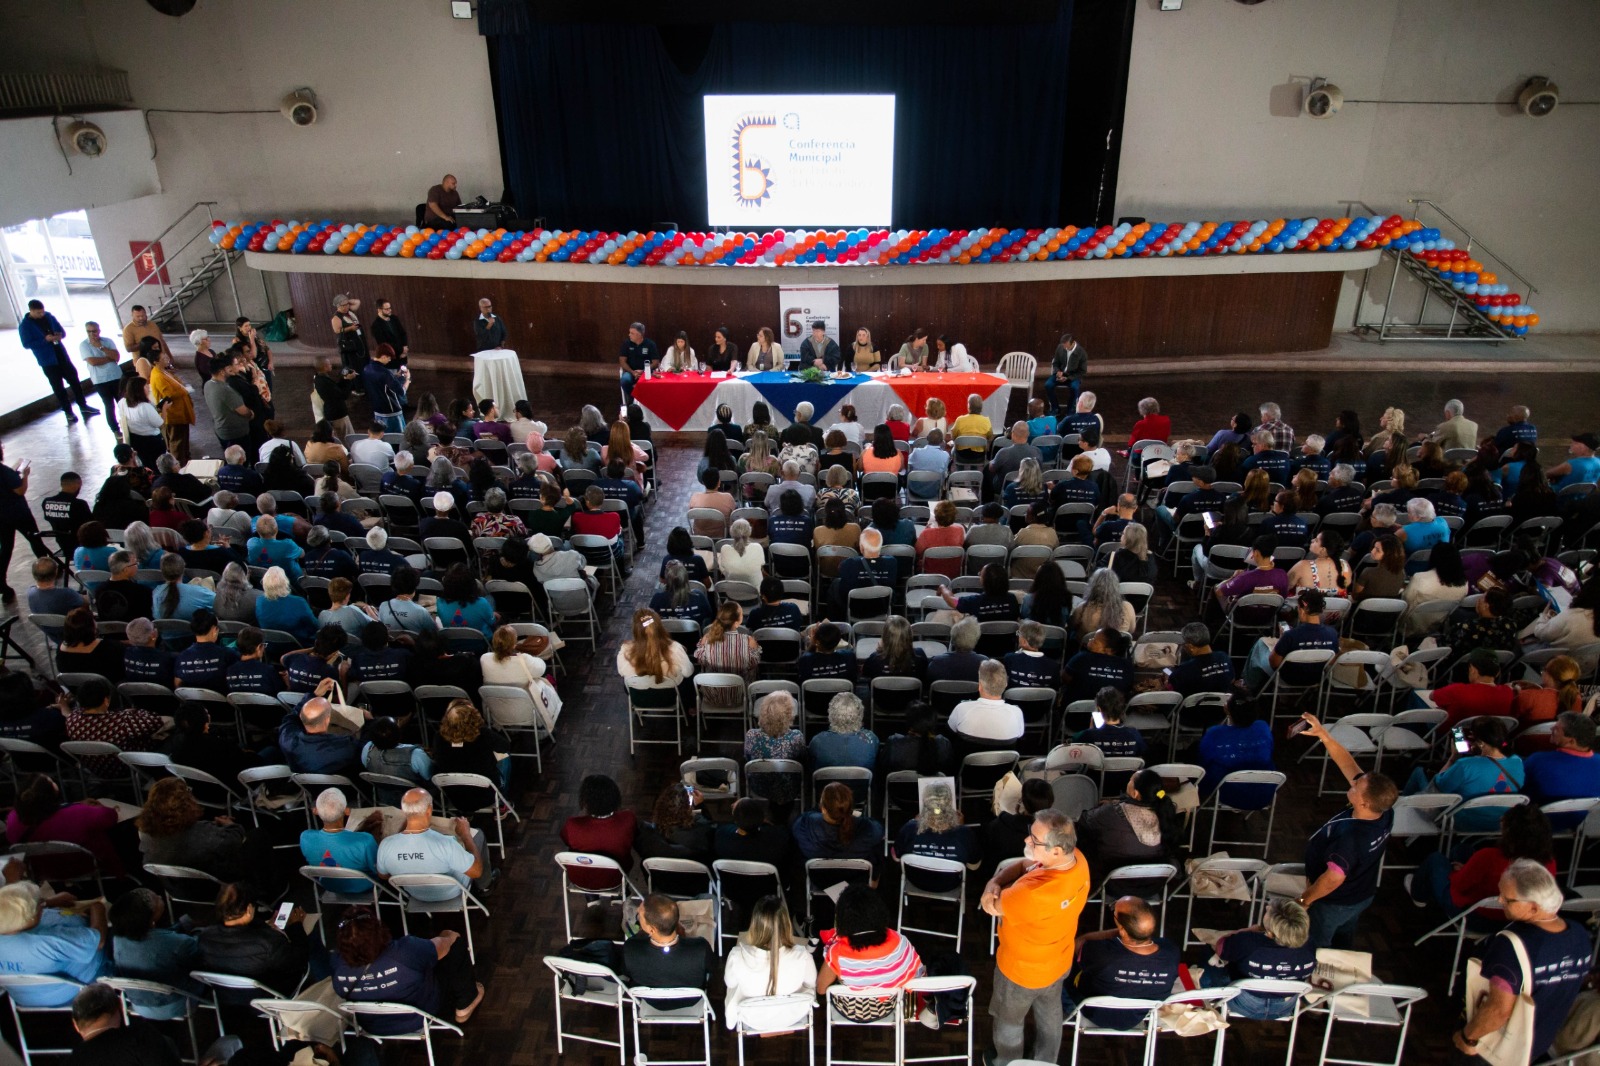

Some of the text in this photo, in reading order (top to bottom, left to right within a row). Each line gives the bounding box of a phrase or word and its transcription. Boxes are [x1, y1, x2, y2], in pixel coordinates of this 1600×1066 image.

[789, 152, 842, 165] Municipal
[43, 255, 76, 272] ODEM
[45, 503, 71, 512] ORDEM
[45, 510, 70, 519] PÚBLICA
[397, 852, 425, 861] FEVRE
